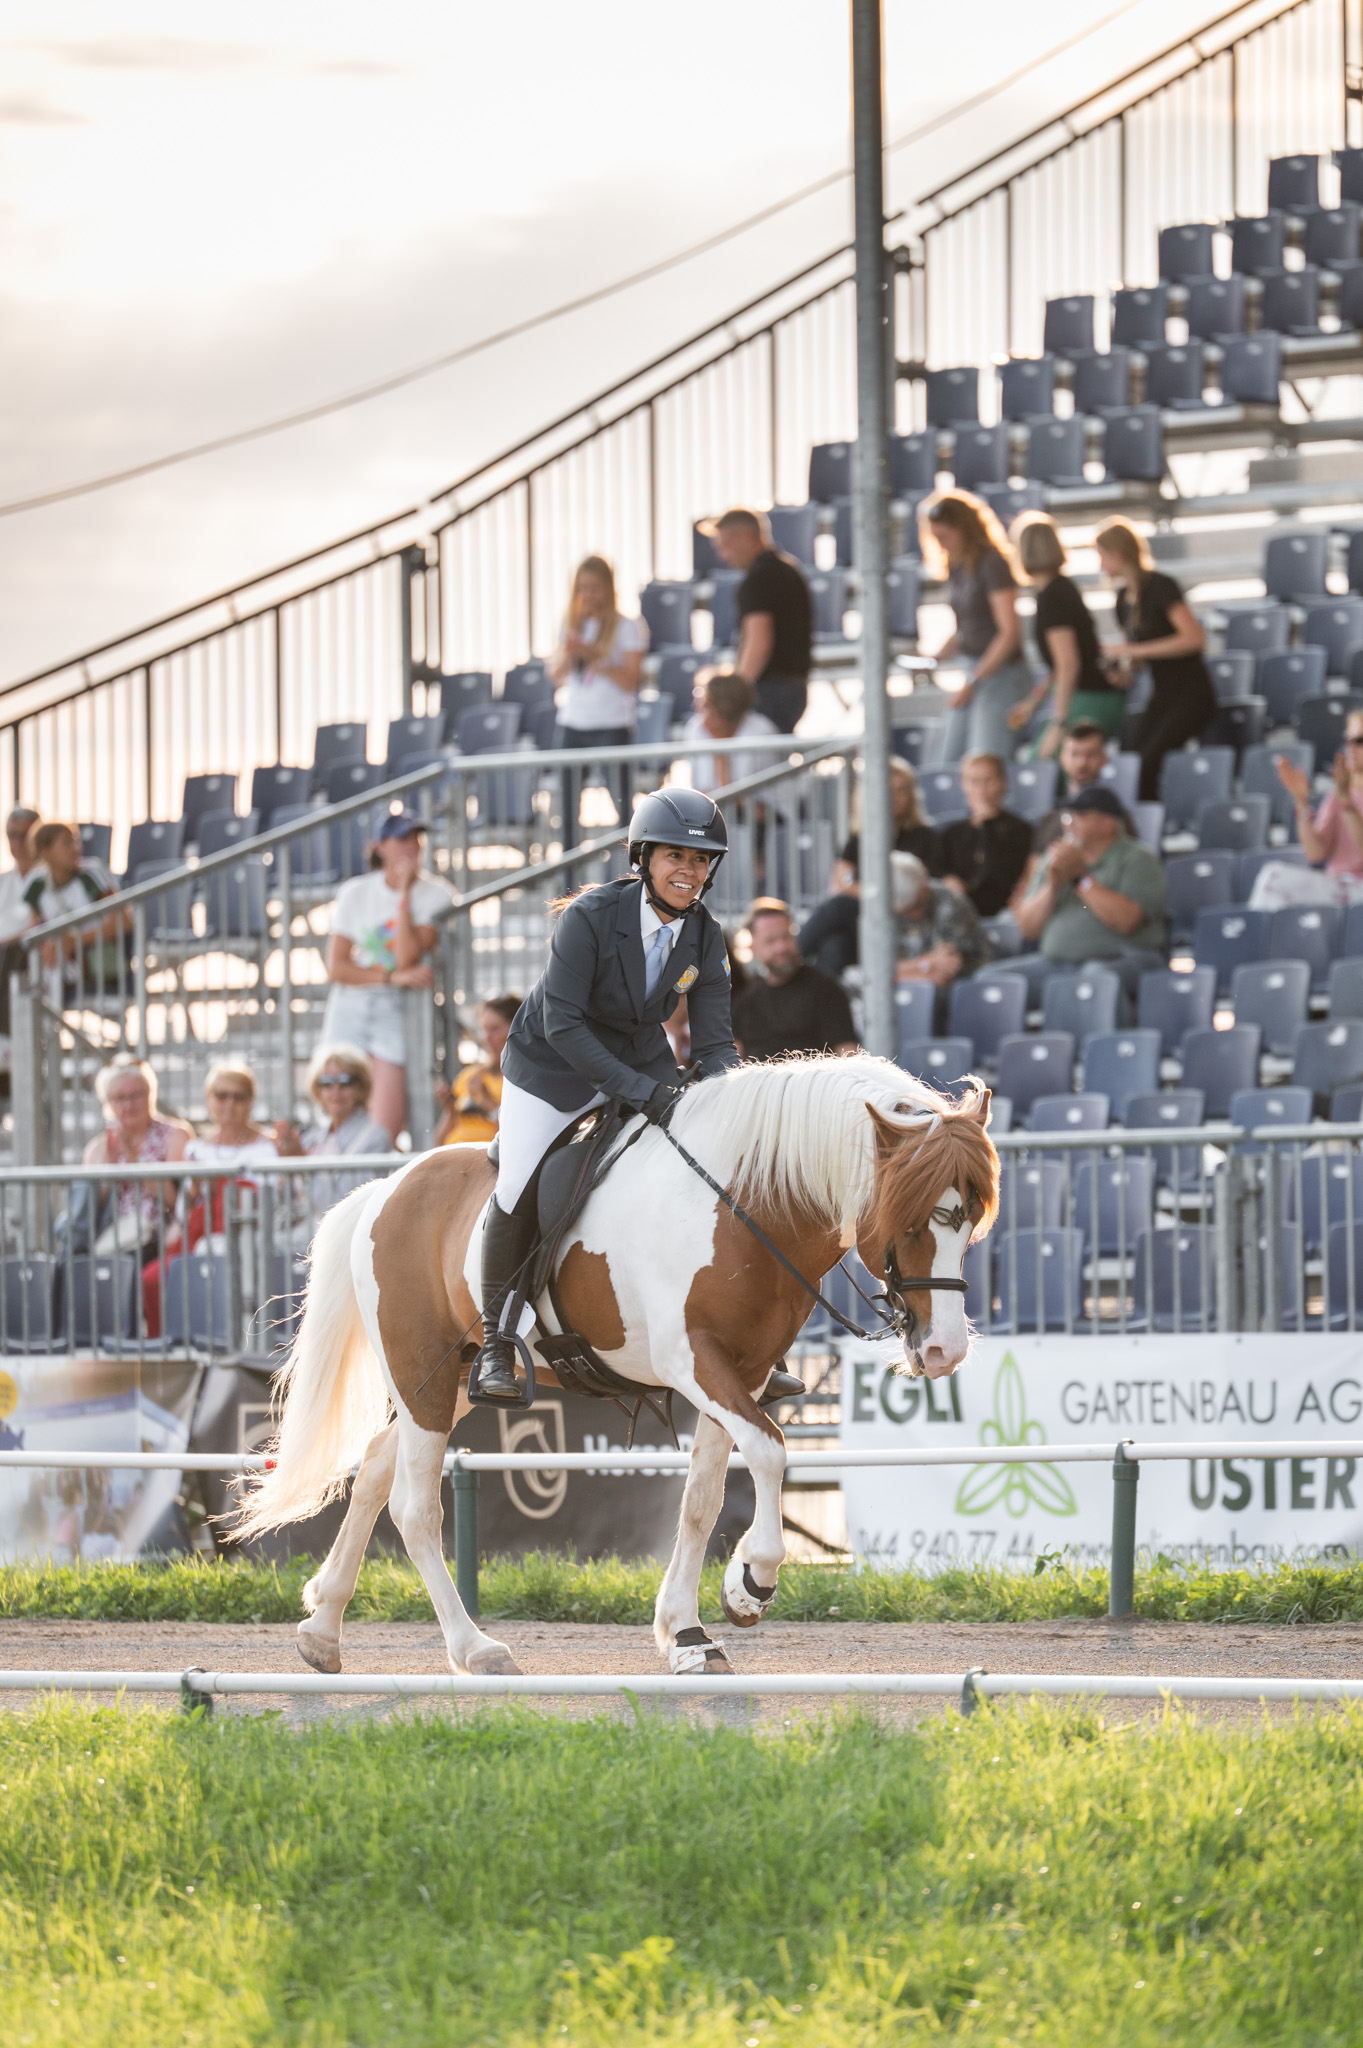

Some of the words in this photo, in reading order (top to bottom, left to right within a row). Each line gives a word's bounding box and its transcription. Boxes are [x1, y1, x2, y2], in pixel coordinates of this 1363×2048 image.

[688, 829, 706, 837] uvex
[852, 1362, 963, 1425] EGLI
[1061, 1379, 1278, 1425] GARTENBAU
[1295, 1379, 1363, 1424] AG
[1189, 1456, 1357, 1512] USTER
[910, 1529, 959, 1558] 940
[1007, 1530, 1035, 1557] 44
